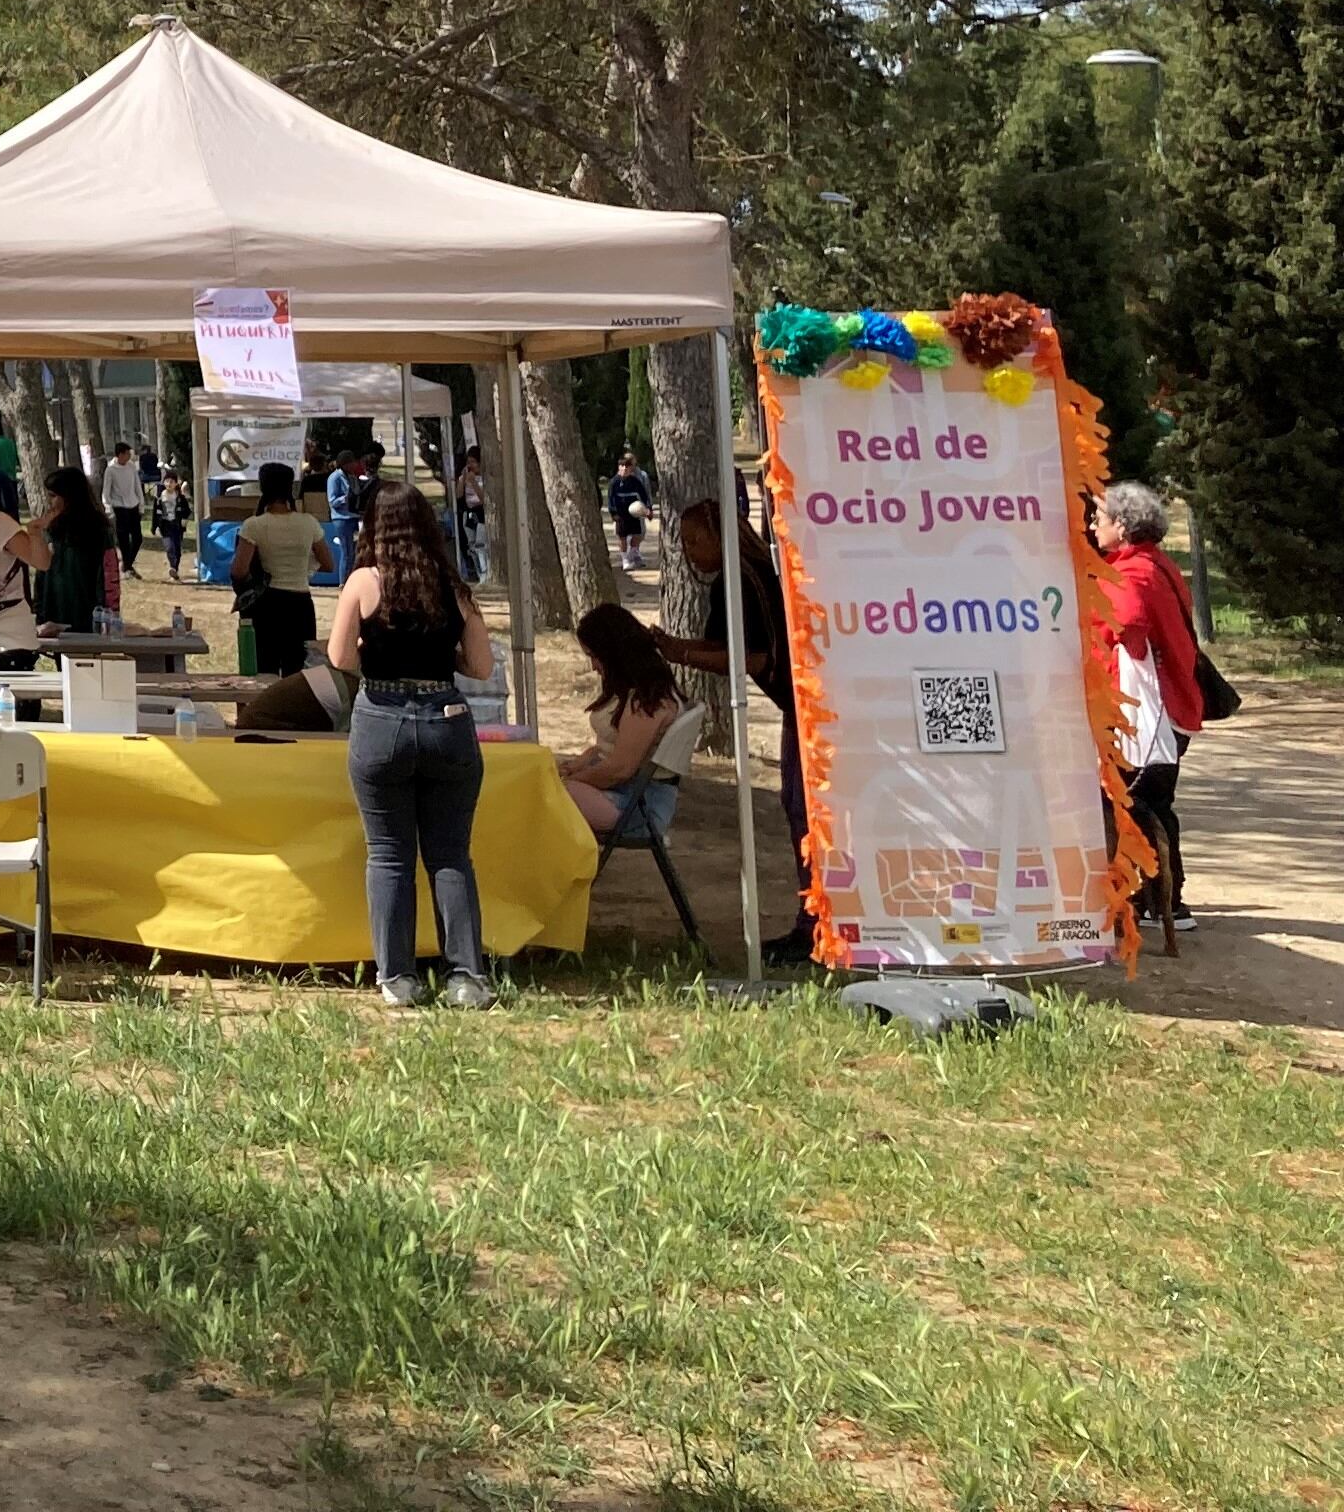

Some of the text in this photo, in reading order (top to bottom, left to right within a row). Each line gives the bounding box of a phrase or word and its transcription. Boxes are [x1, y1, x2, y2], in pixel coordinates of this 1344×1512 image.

[611, 316, 682, 327] MASTERTENT
[244, 348, 253, 362] Y
[837, 425, 988, 463] Red de
[806, 488, 1042, 533] Ocio Joven
[1049, 919, 1091, 930] GOBIERNO
[1050, 931, 1060, 941] DE
